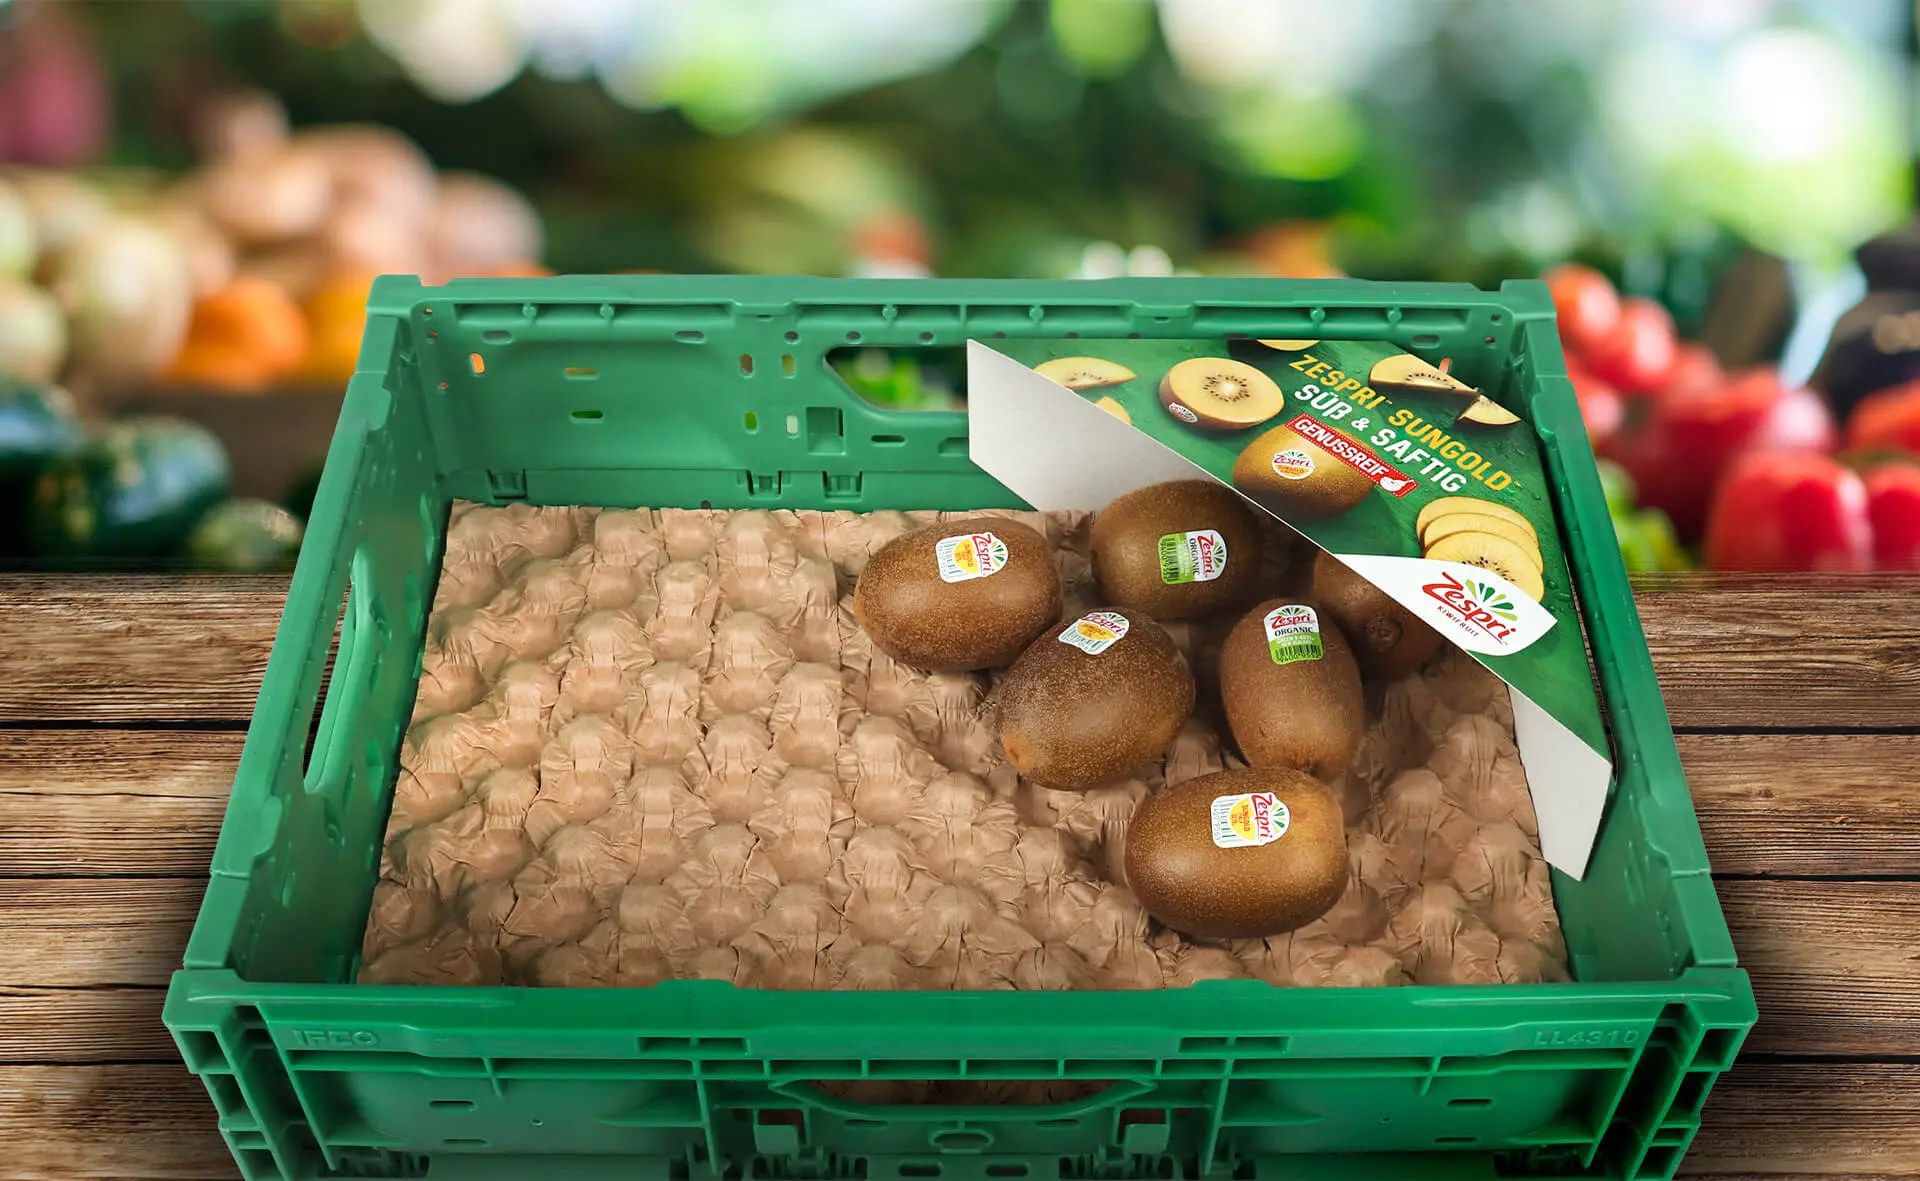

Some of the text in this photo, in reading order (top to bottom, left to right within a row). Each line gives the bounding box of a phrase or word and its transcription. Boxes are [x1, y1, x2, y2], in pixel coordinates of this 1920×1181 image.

[1288, 354, 1512, 491] ZESPRI SUNGOLD
[1295, 418, 1389, 476] GENUSSREIF
[1351, 417, 1370, 432] &
[1370, 428, 1467, 492] SAFTIG
[972, 533, 995, 572] Zespri
[1189, 538, 1201, 576] ORGANIC
[1197, 534, 1215, 573] Zespri
[1270, 614, 1310, 629] Zespri
[1422, 571, 1517, 642] Zespri
[1436, 605, 1479, 638] KIWIFRUIT
[1274, 626, 1313, 637] ORGANIC
[1251, 794, 1273, 838] Zespri
[292, 1030, 378, 1047] IFCO
